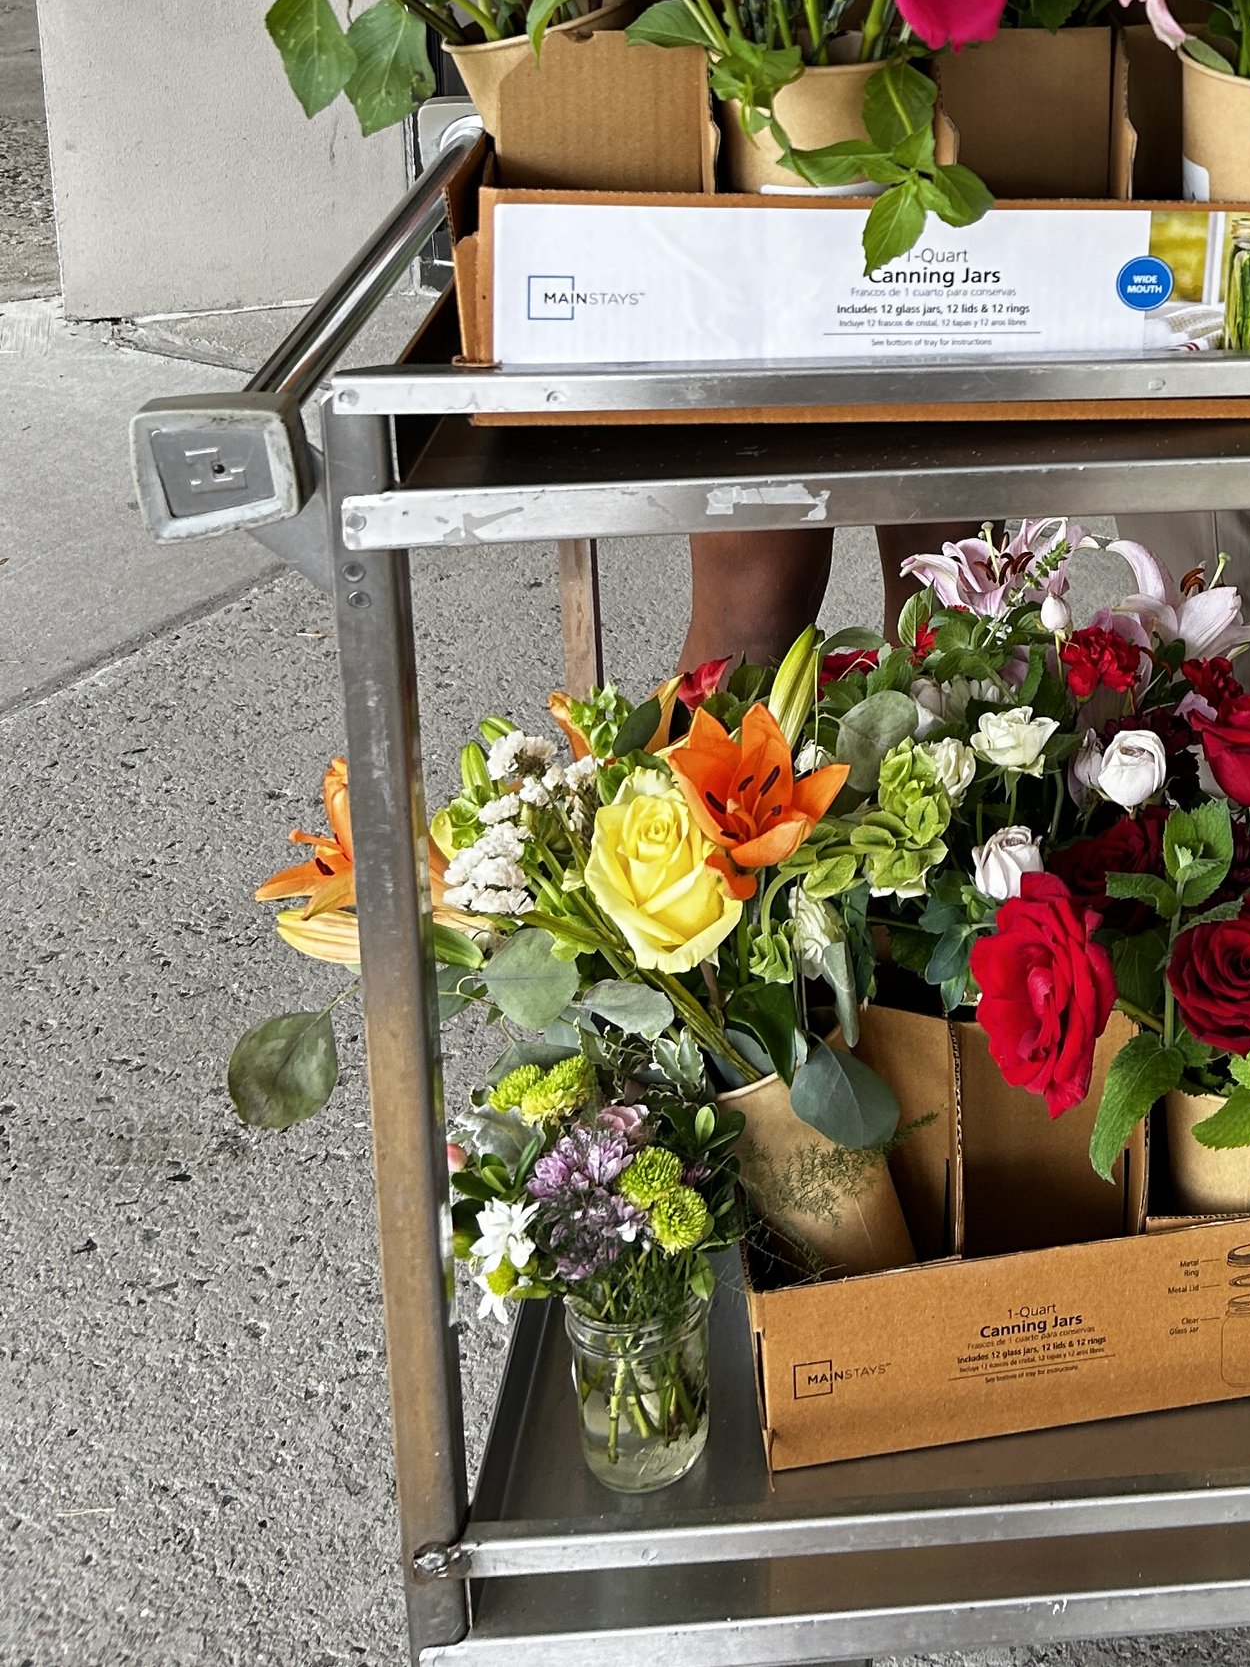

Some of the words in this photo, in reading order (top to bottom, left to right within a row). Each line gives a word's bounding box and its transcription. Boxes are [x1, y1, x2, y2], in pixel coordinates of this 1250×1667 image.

[907, 247, 969, 265] 1-Quart
[868, 266, 955, 288] Canning
[961, 266, 1001, 283] Jars
[1132, 274, 1158, 284] WIDE
[851, 287, 887, 297] Frascos
[889, 287, 901, 297] de
[913, 287, 945, 297] cuarto
[946, 288, 969, 299] para
[970, 288, 1017, 297] conservas
[1127, 284, 1163, 294] MOUTH
[836, 303, 878, 314] Includes
[881, 303, 894, 314] 12
[895, 303, 921, 317] glass
[922, 303, 944, 316] jars,
[947, 303, 959, 314] 12
[961, 303, 979, 314] lids
[981, 303, 989, 313] &
[992, 303, 1004, 313] 12
[1006, 302, 1031, 316] rings
[839, 319, 865, 329] Incluye
[867, 319, 877, 327] 12
[877, 319, 903, 327] frascos
[904, 319, 915, 327] de
[941, 318, 951, 327] 12
[980, 318, 990, 327] 12
[871, 338, 885, 347] See
[886, 338, 913, 347] bottom
[914, 338, 922, 347] of
[923, 338, 938, 349] tray
[939, 337, 950, 346] for
[951, 336, 993, 347] instructions
[1183, 1270, 1200, 1278] Ring
[1167, 1285, 1188, 1294] Metal
[1189, 1284, 1199, 1292] Lid
[1007, 1303, 1057, 1319] 1-Quart
[979, 1319, 1047, 1339] Canning
[1051, 1314, 1083, 1329] Jars
[996, 1338, 1006, 1346] de
[1014, 1334, 1039, 1343] cuarto
[1040, 1331, 1058, 1340] para
[957, 1353, 989, 1364] Includes
[991, 1350, 1001, 1359] 12
[1002, 1348, 1022, 1359] glass
[1042, 1343, 1051, 1352] 12
[1052, 1341, 1066, 1350] lids
[1067, 1340, 1074, 1348] &
[1076, 1338, 1086, 1347] 12
[1087, 1336, 1107, 1345] rings
